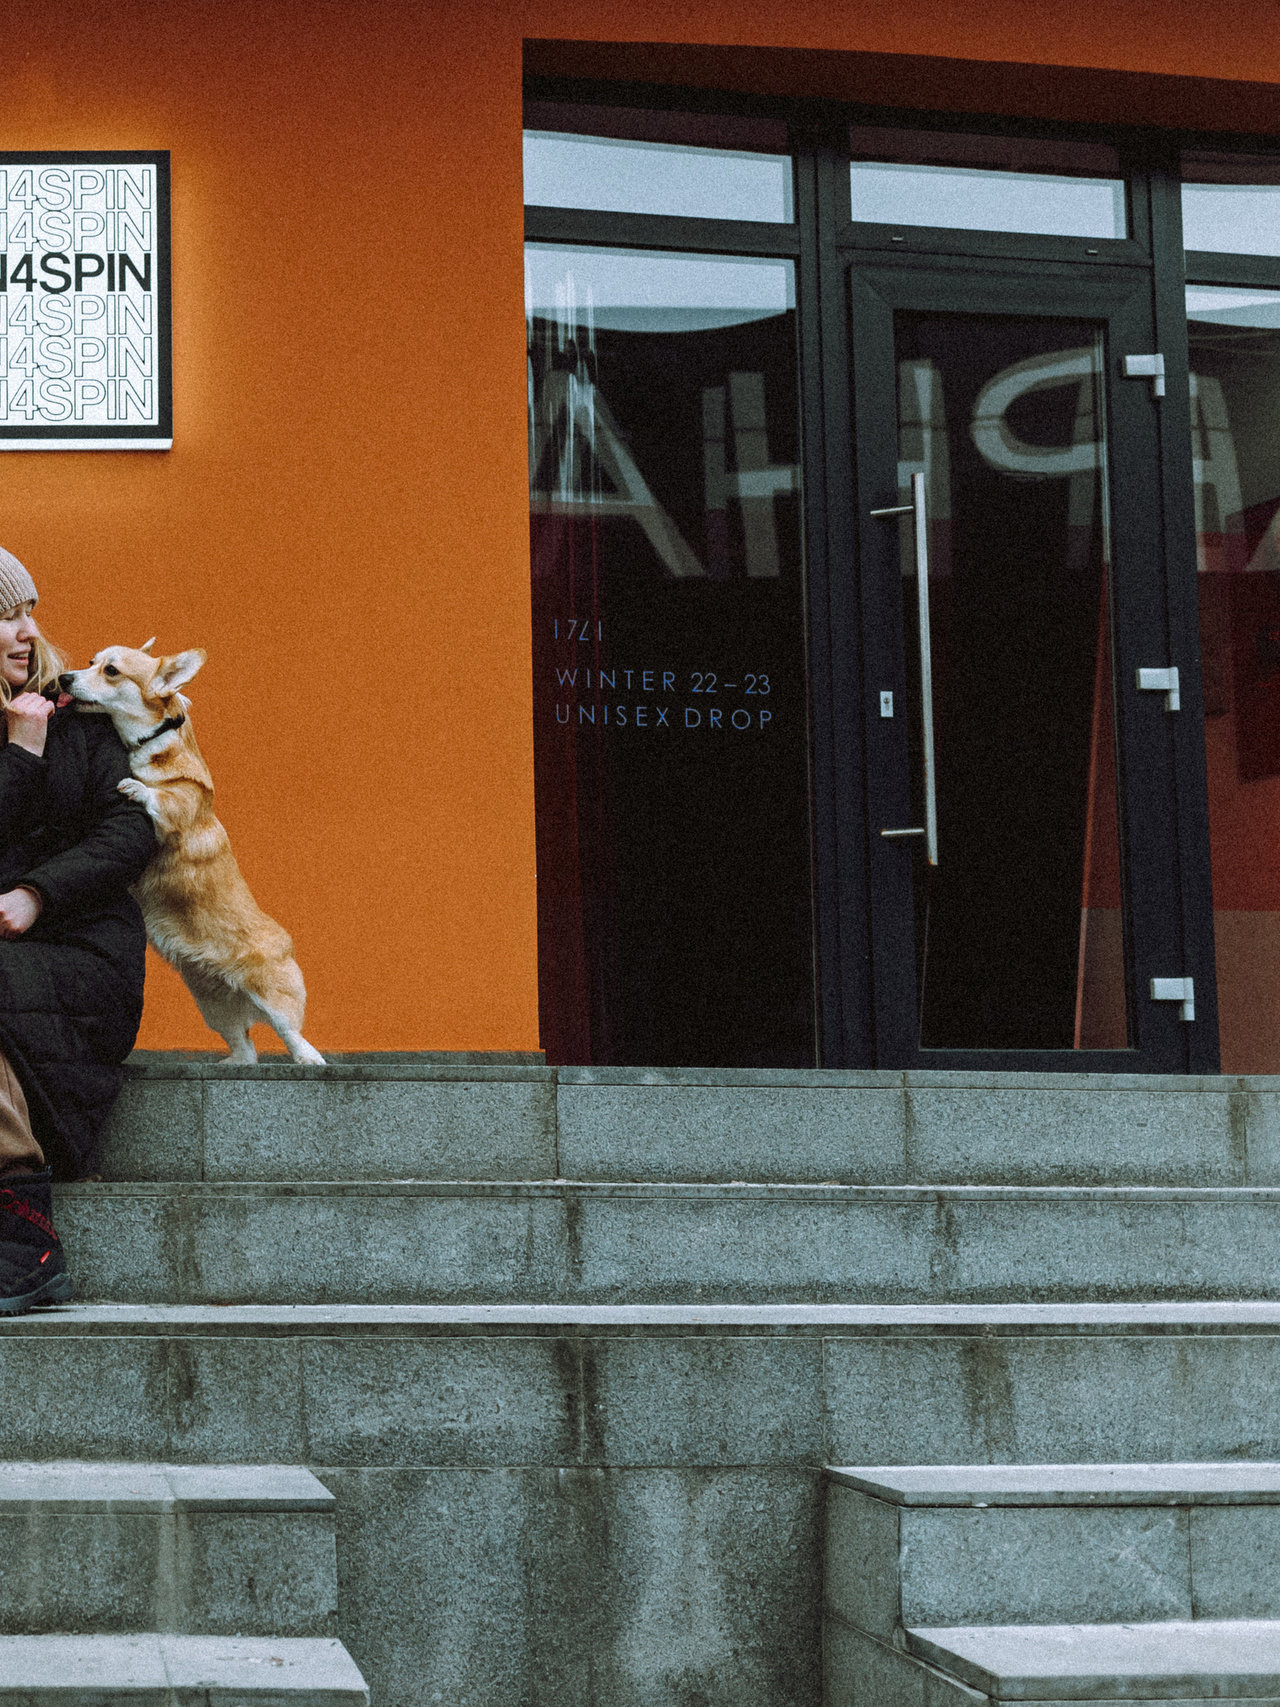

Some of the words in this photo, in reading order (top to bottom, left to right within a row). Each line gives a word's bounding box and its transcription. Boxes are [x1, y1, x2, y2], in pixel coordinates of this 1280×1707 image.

[556, 668, 676, 692] WINTER
[555, 703, 669, 728] UNISEX
[685, 708, 772, 730] DROP
